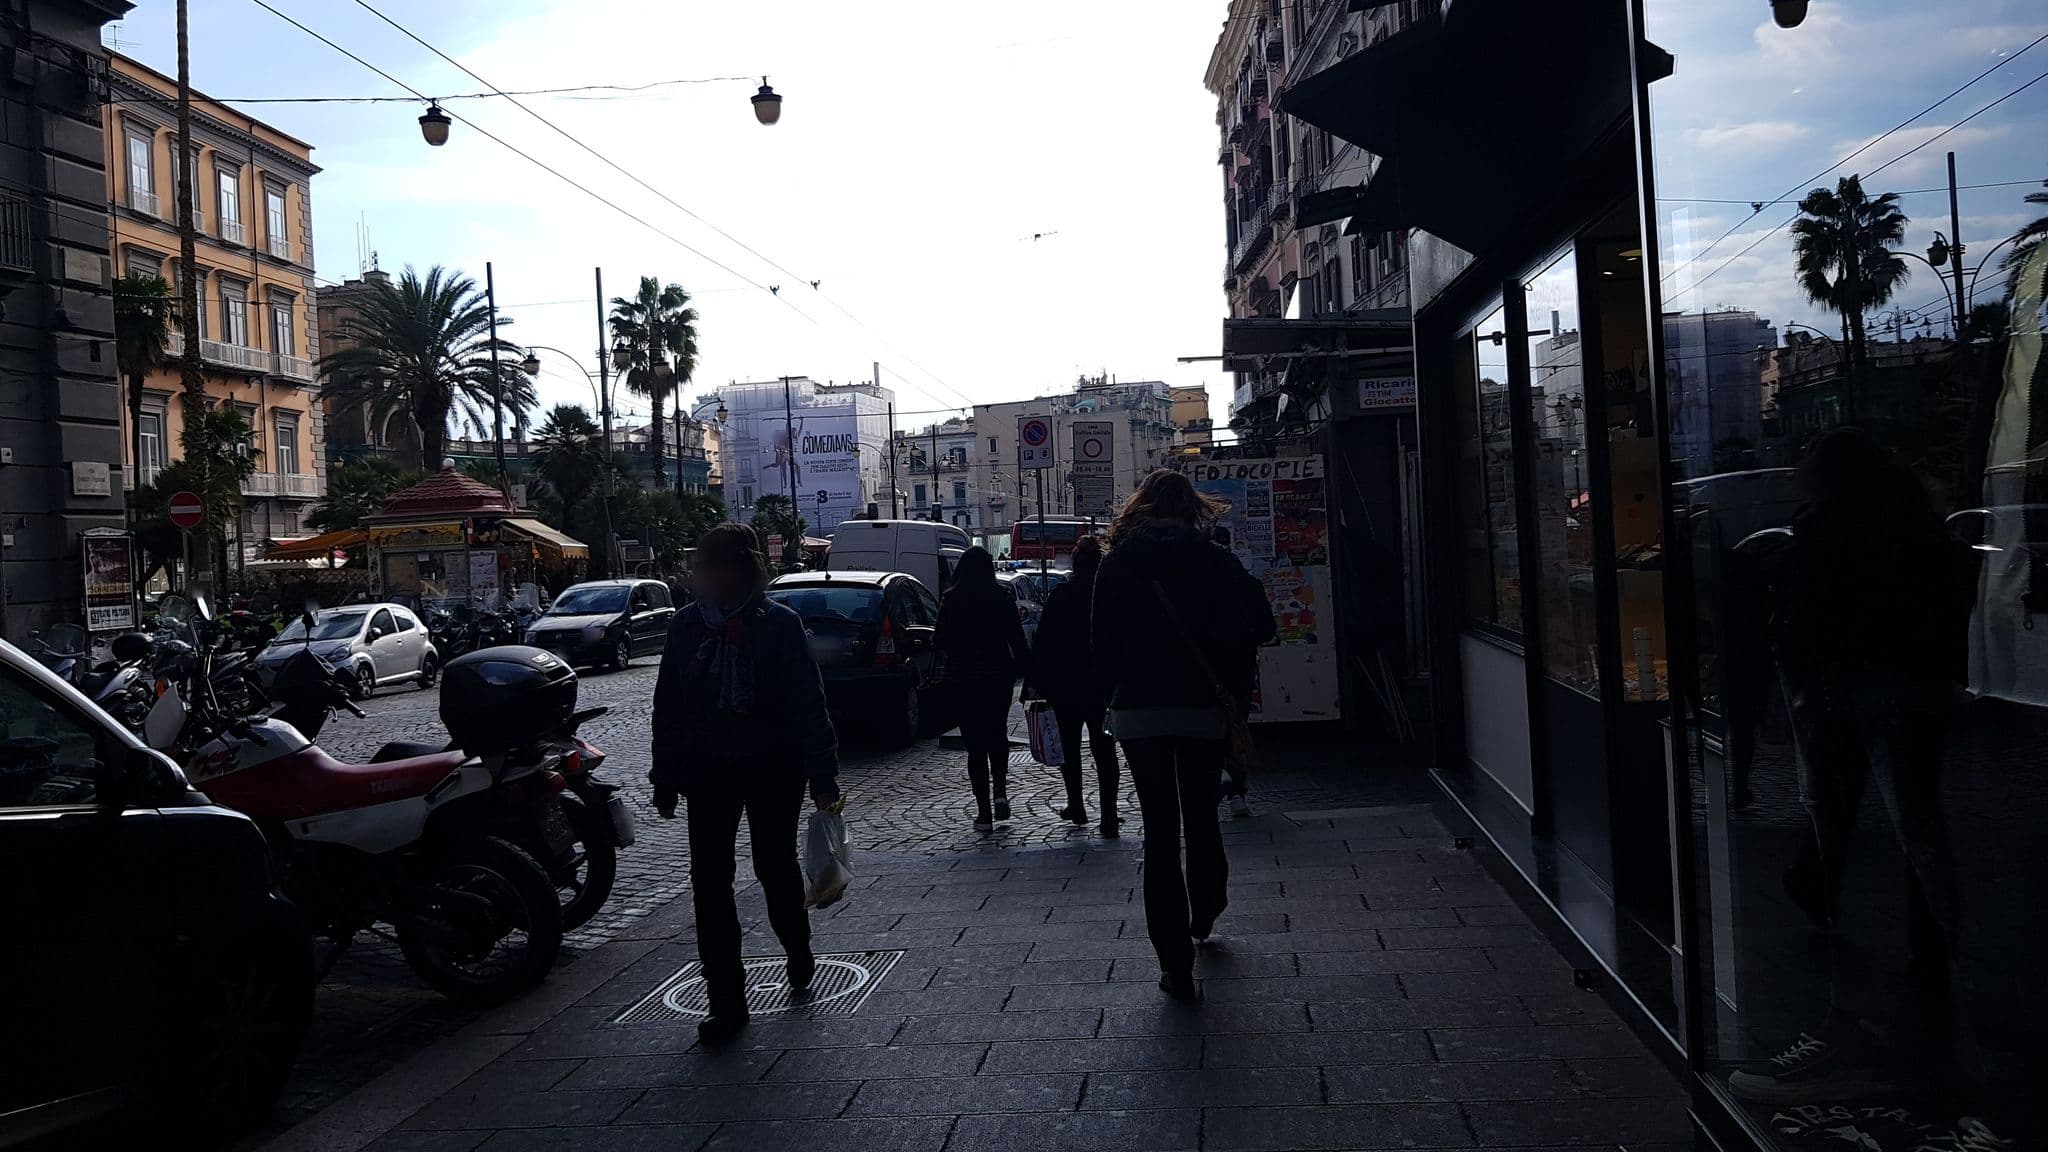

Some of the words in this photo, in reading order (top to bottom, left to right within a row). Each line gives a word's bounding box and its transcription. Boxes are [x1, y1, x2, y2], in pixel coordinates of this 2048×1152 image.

[1365, 379, 1415, 389] Ricari
[802, 434, 854, 454] COMEDIANS
[1195, 460, 1316, 481] FOTOCOPIE
